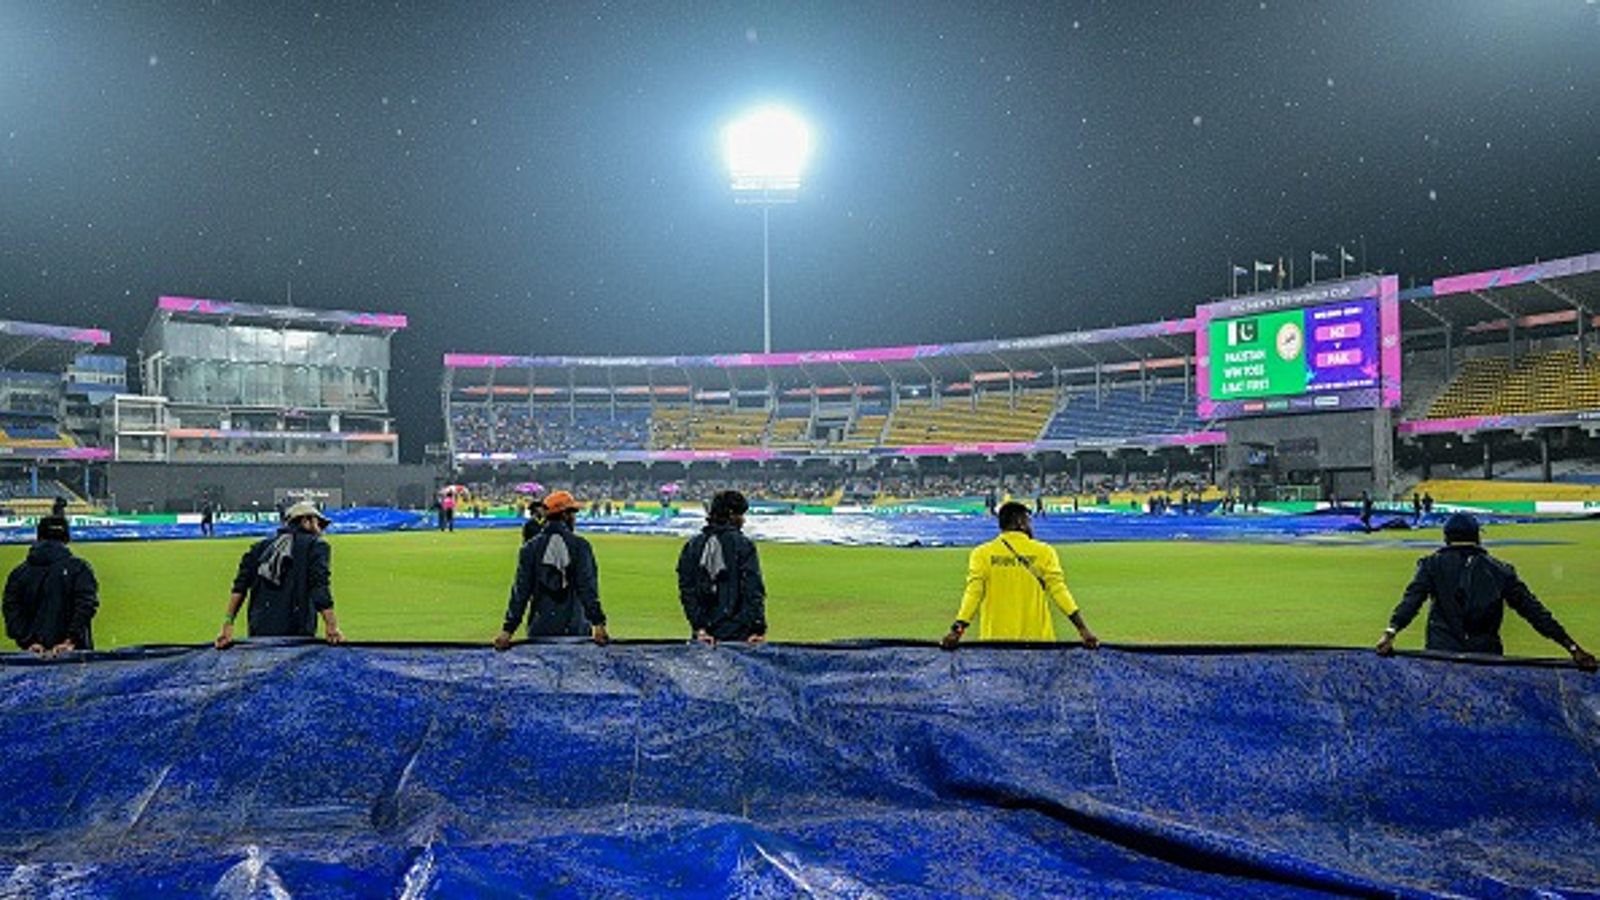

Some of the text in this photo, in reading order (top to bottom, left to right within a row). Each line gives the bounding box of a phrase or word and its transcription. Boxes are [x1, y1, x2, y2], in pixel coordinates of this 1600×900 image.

[1330, 287, 1351, 298] CUP
[1224, 349, 1267, 363] PAKISTAN
[1327, 352, 1351, 365] PAK
[1223, 364, 1265, 378] WIN TOSS
[1246, 378, 1270, 391] FIRST
